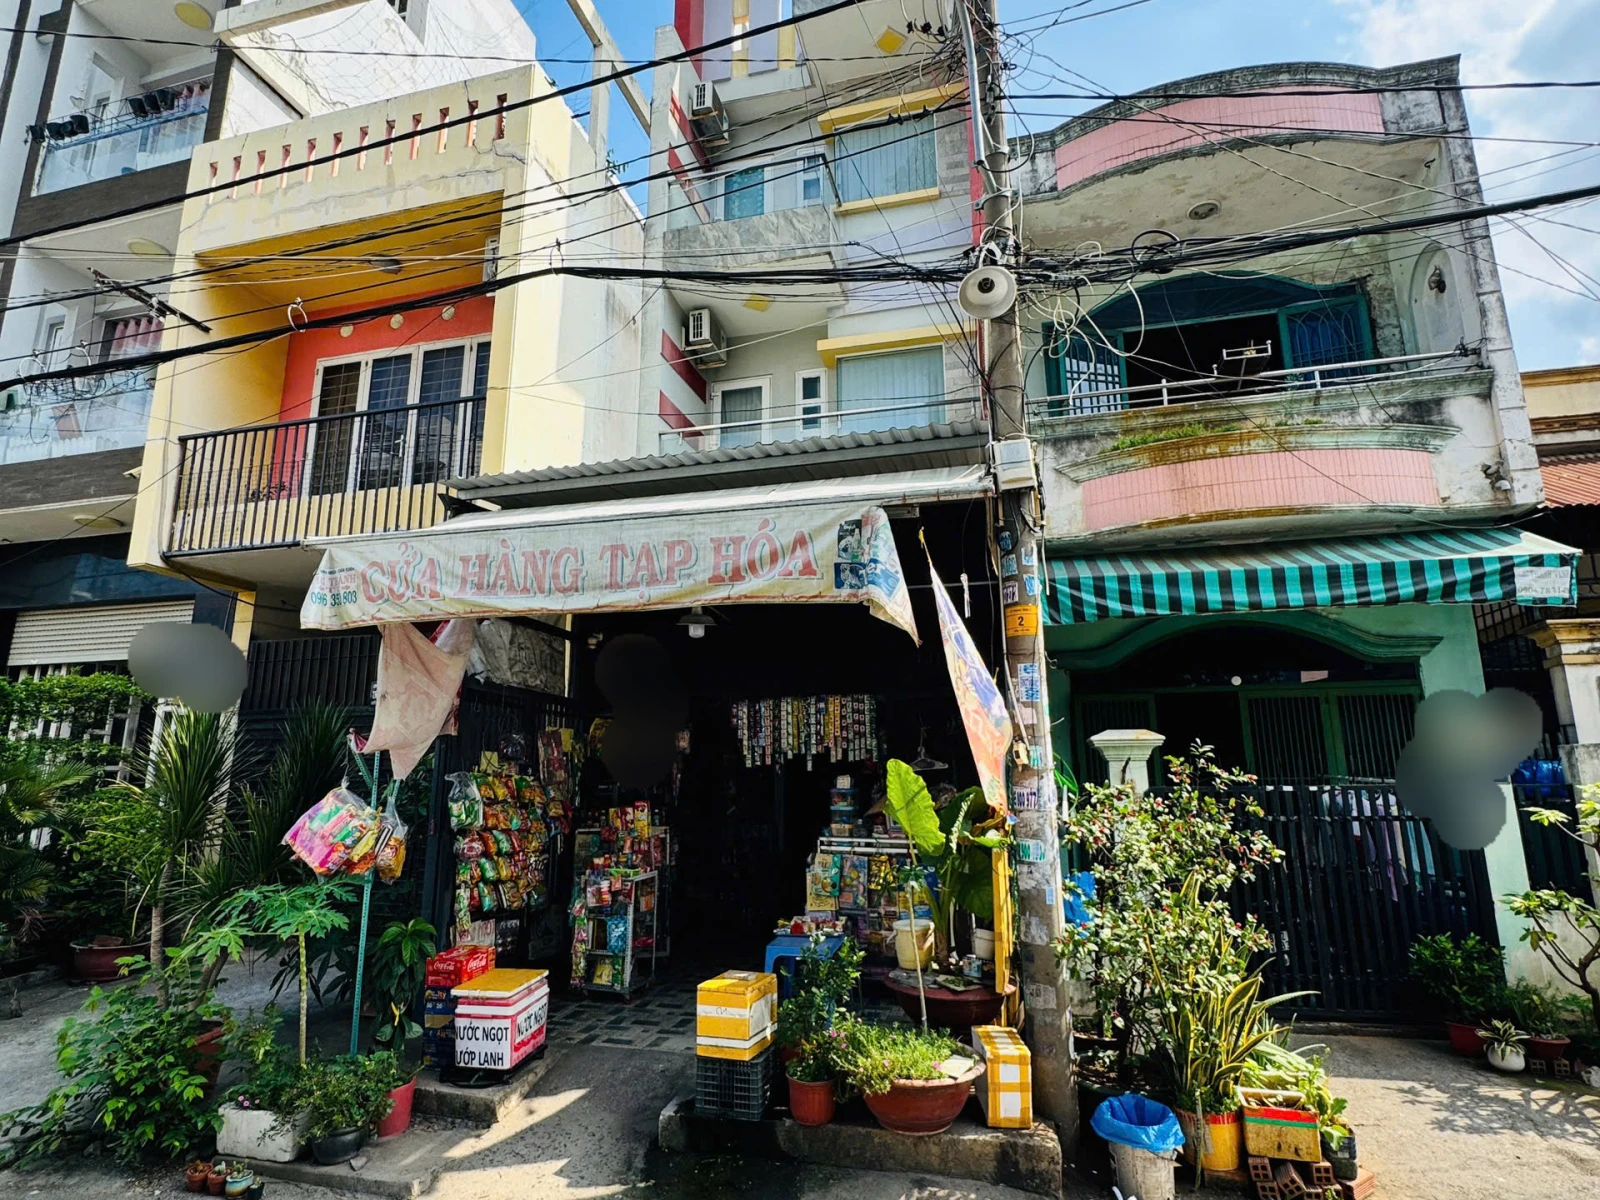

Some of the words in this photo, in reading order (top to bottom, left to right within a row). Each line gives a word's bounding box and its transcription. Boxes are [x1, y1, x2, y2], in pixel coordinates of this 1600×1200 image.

[361, 541, 442, 603] CỬA
[454, 538, 583, 597] HÀNG
[600, 539, 694, 600] TẠP
[707, 518, 819, 582] HÓA
[1017, 616, 1024, 627] 2
[482, 1026, 510, 1045] NGỌT
